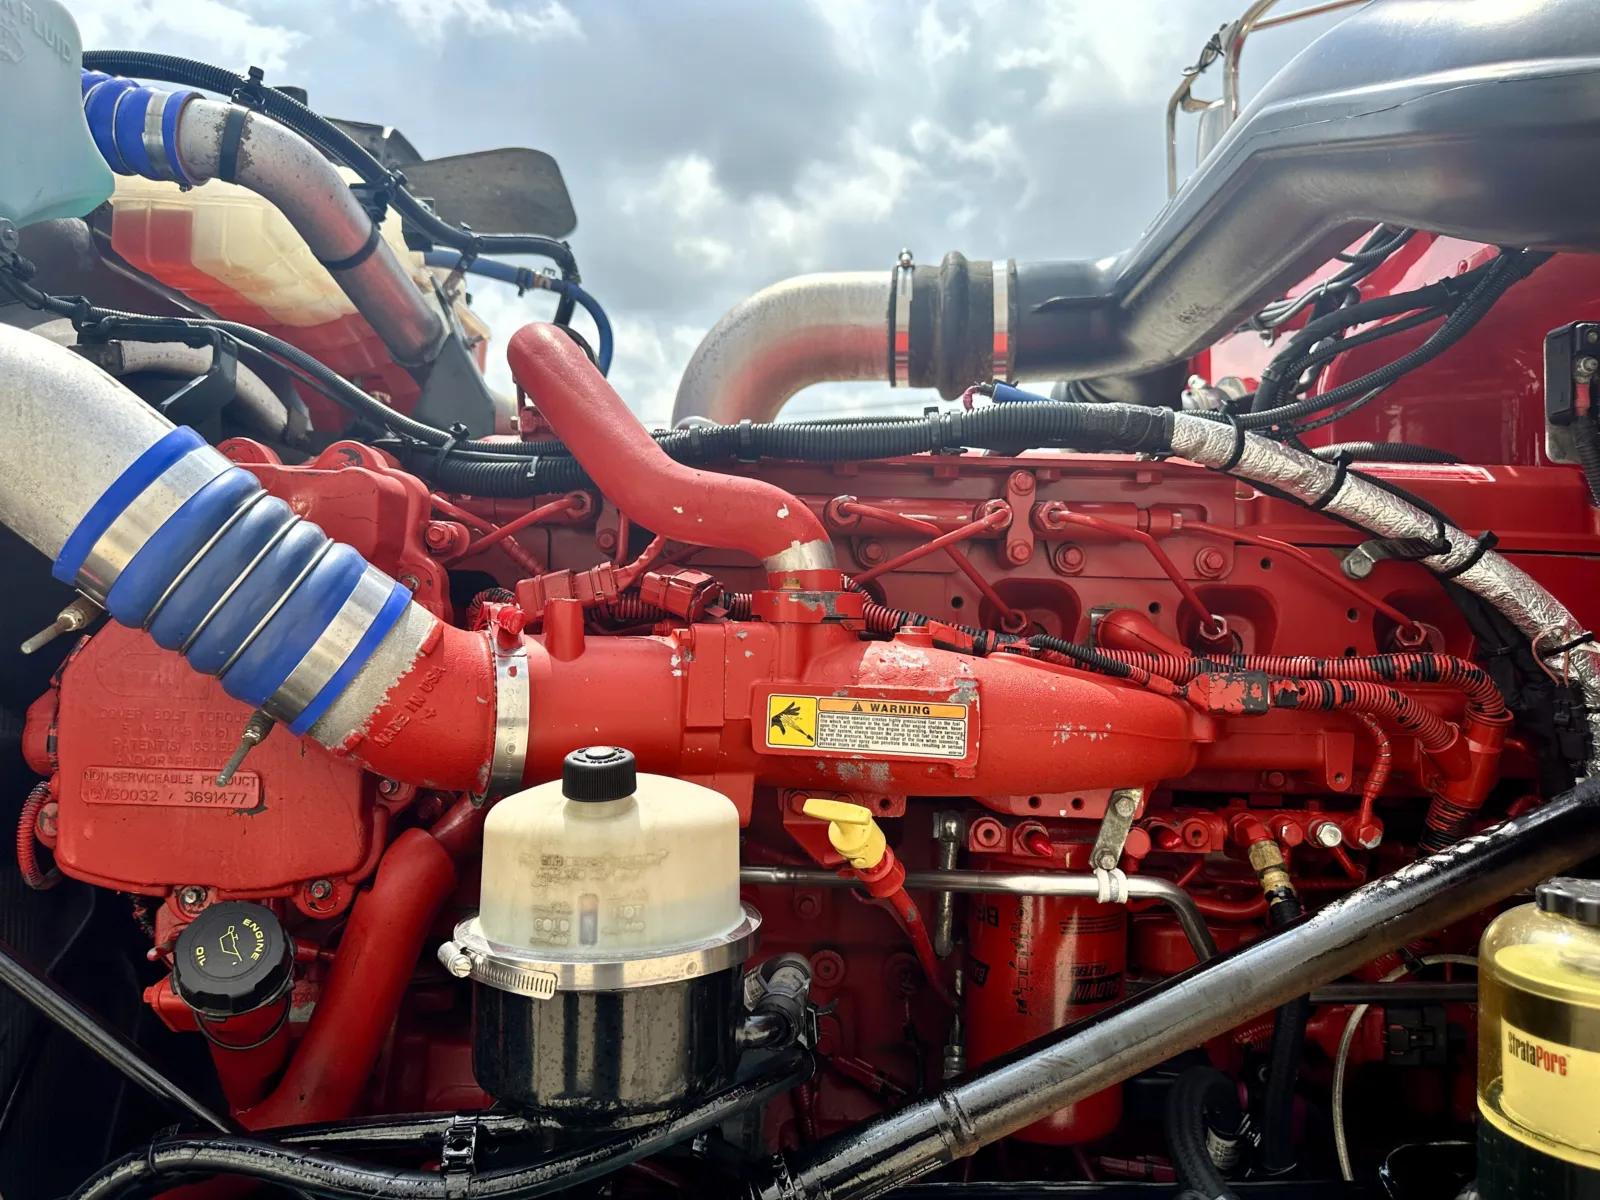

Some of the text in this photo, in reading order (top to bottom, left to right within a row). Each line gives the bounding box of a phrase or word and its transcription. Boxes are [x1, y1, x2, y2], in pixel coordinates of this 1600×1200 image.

[20, 1, 73, 64] FLUID
[373, 665, 447, 748] MADE IN USA
[870, 703, 931, 715] WARNING
[83, 769, 257, 788] NON-SERVICEABLE PRDUCT
[184, 790, 248, 805] 3691477
[242, 917, 265, 961] ENGINE
[195, 946, 207, 967] OIL
[1507, 1031, 1568, 1077] StrataPore
